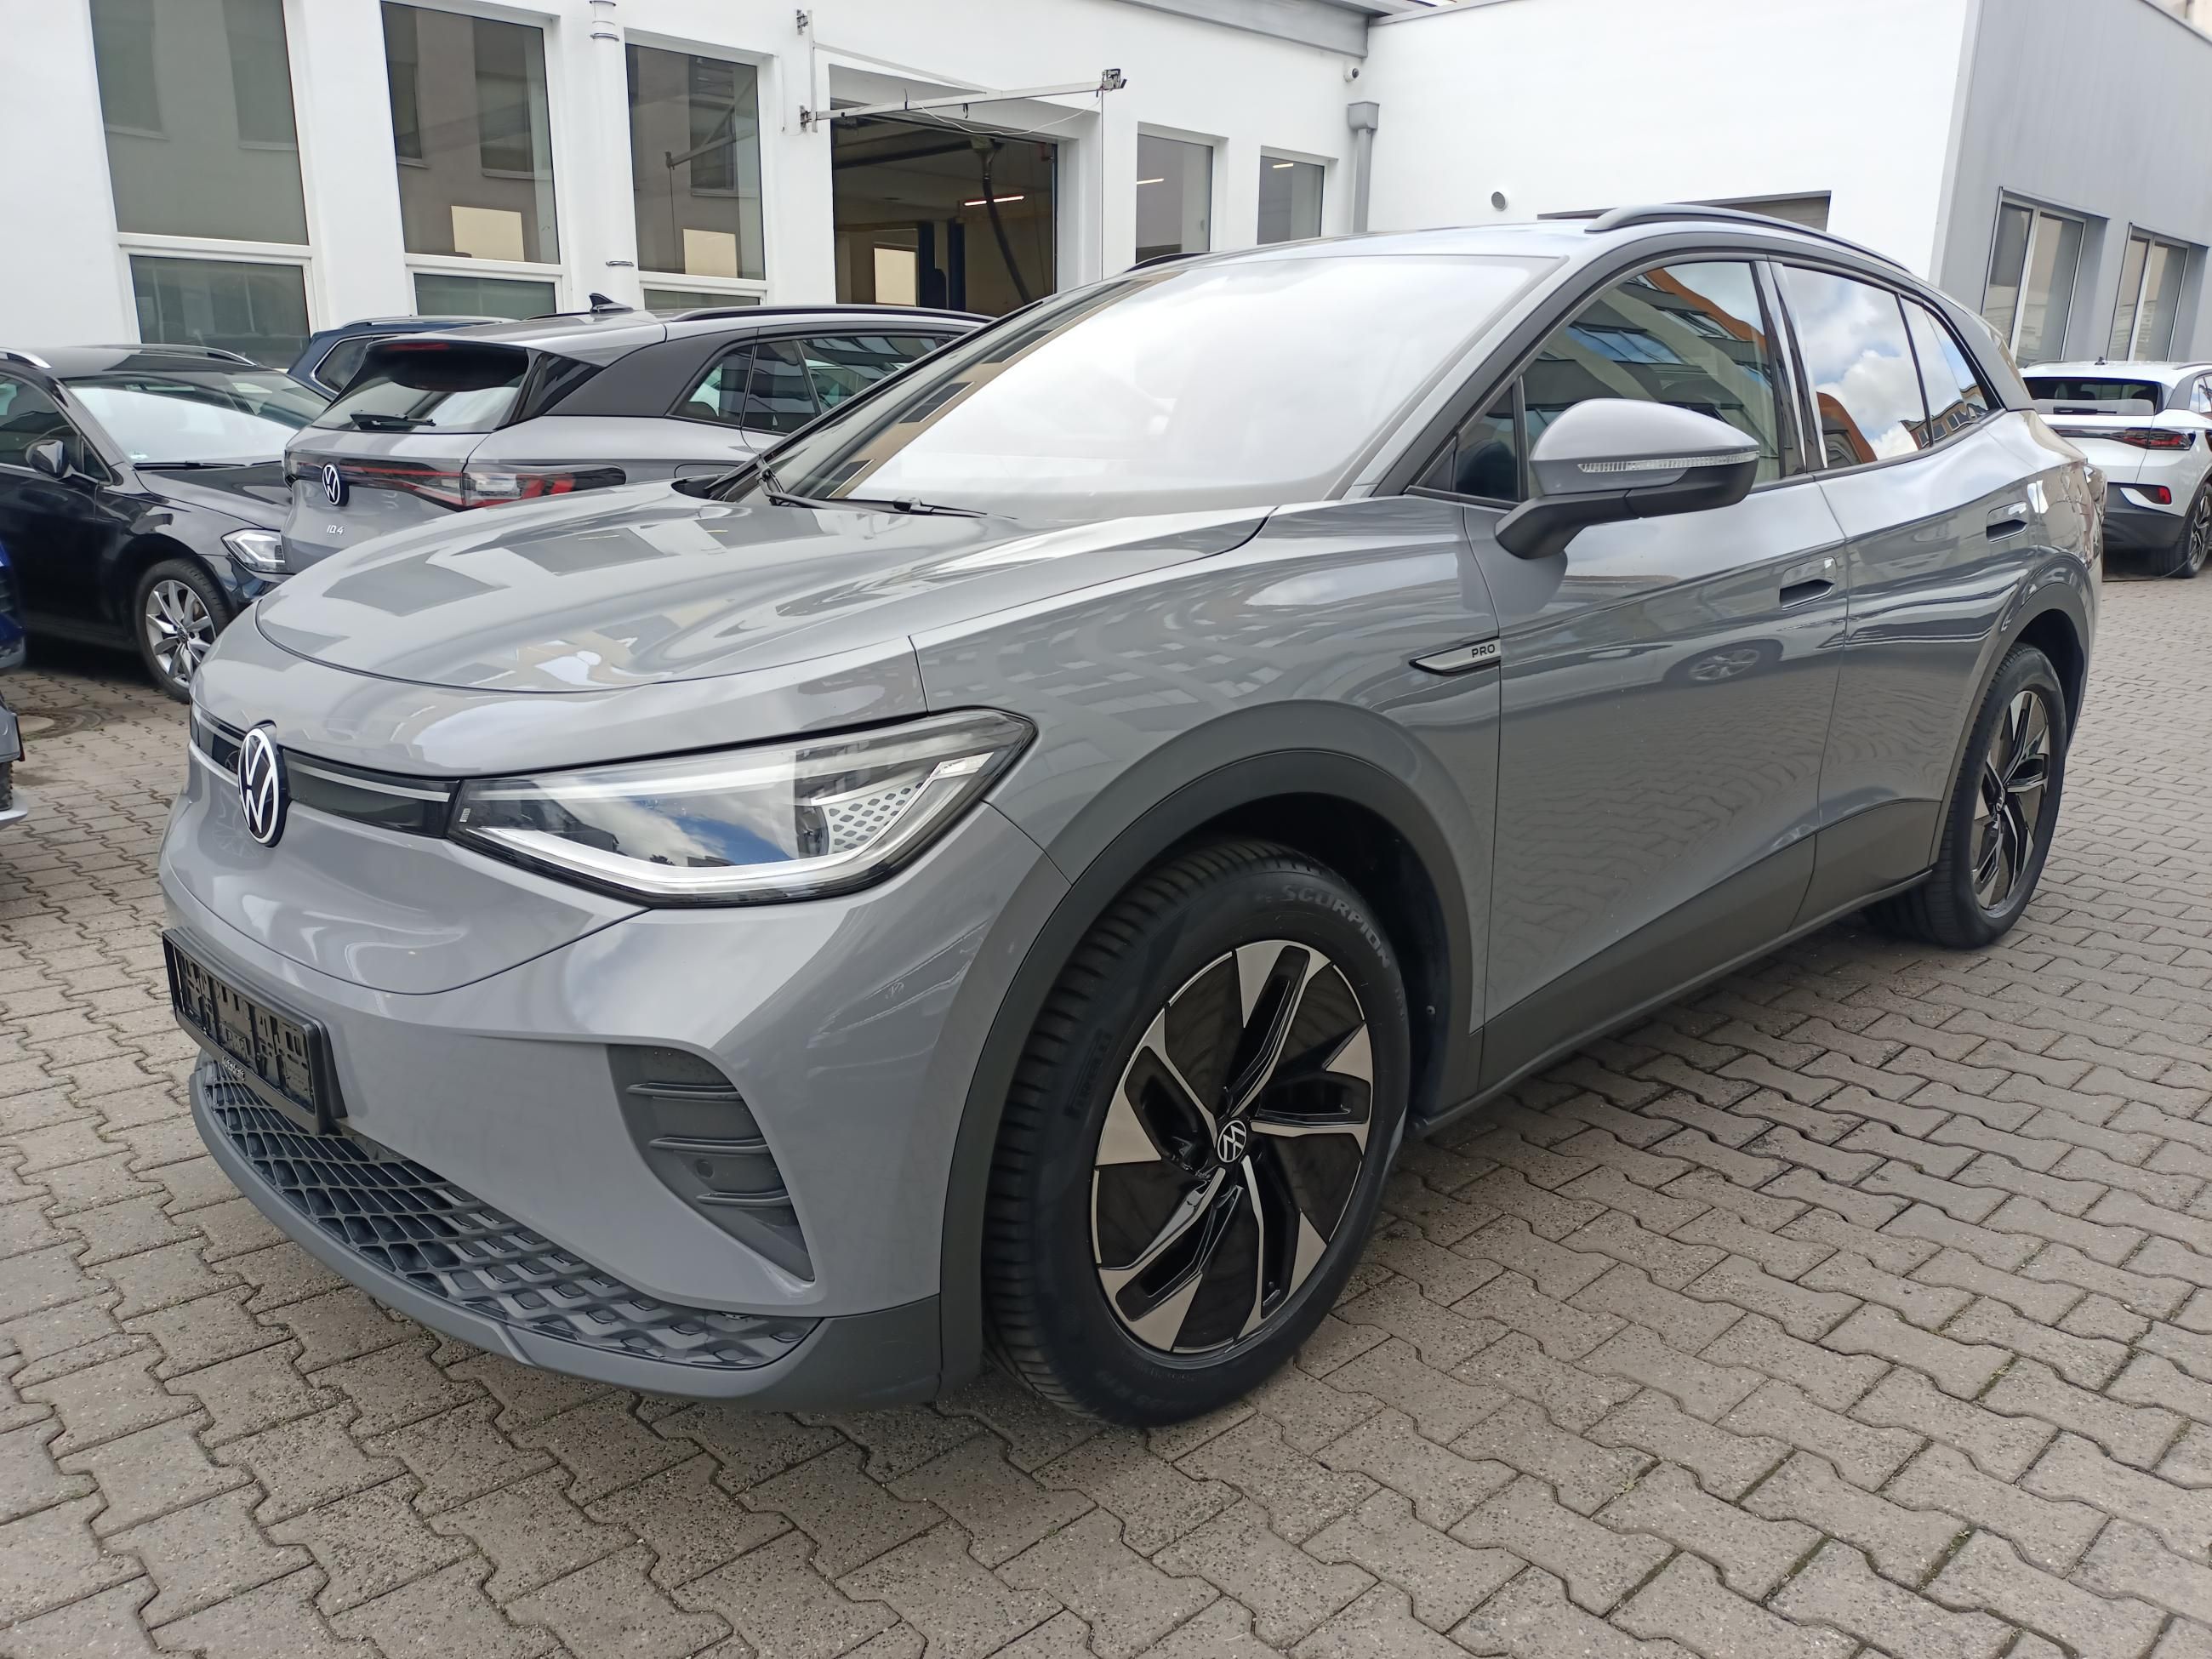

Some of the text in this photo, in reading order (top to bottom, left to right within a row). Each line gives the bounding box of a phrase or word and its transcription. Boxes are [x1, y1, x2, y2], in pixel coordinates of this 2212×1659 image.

[1472, 644, 1495, 658] PRO
[238, 728, 279, 844] VW
[1282, 885, 1390, 968] SCORPION
